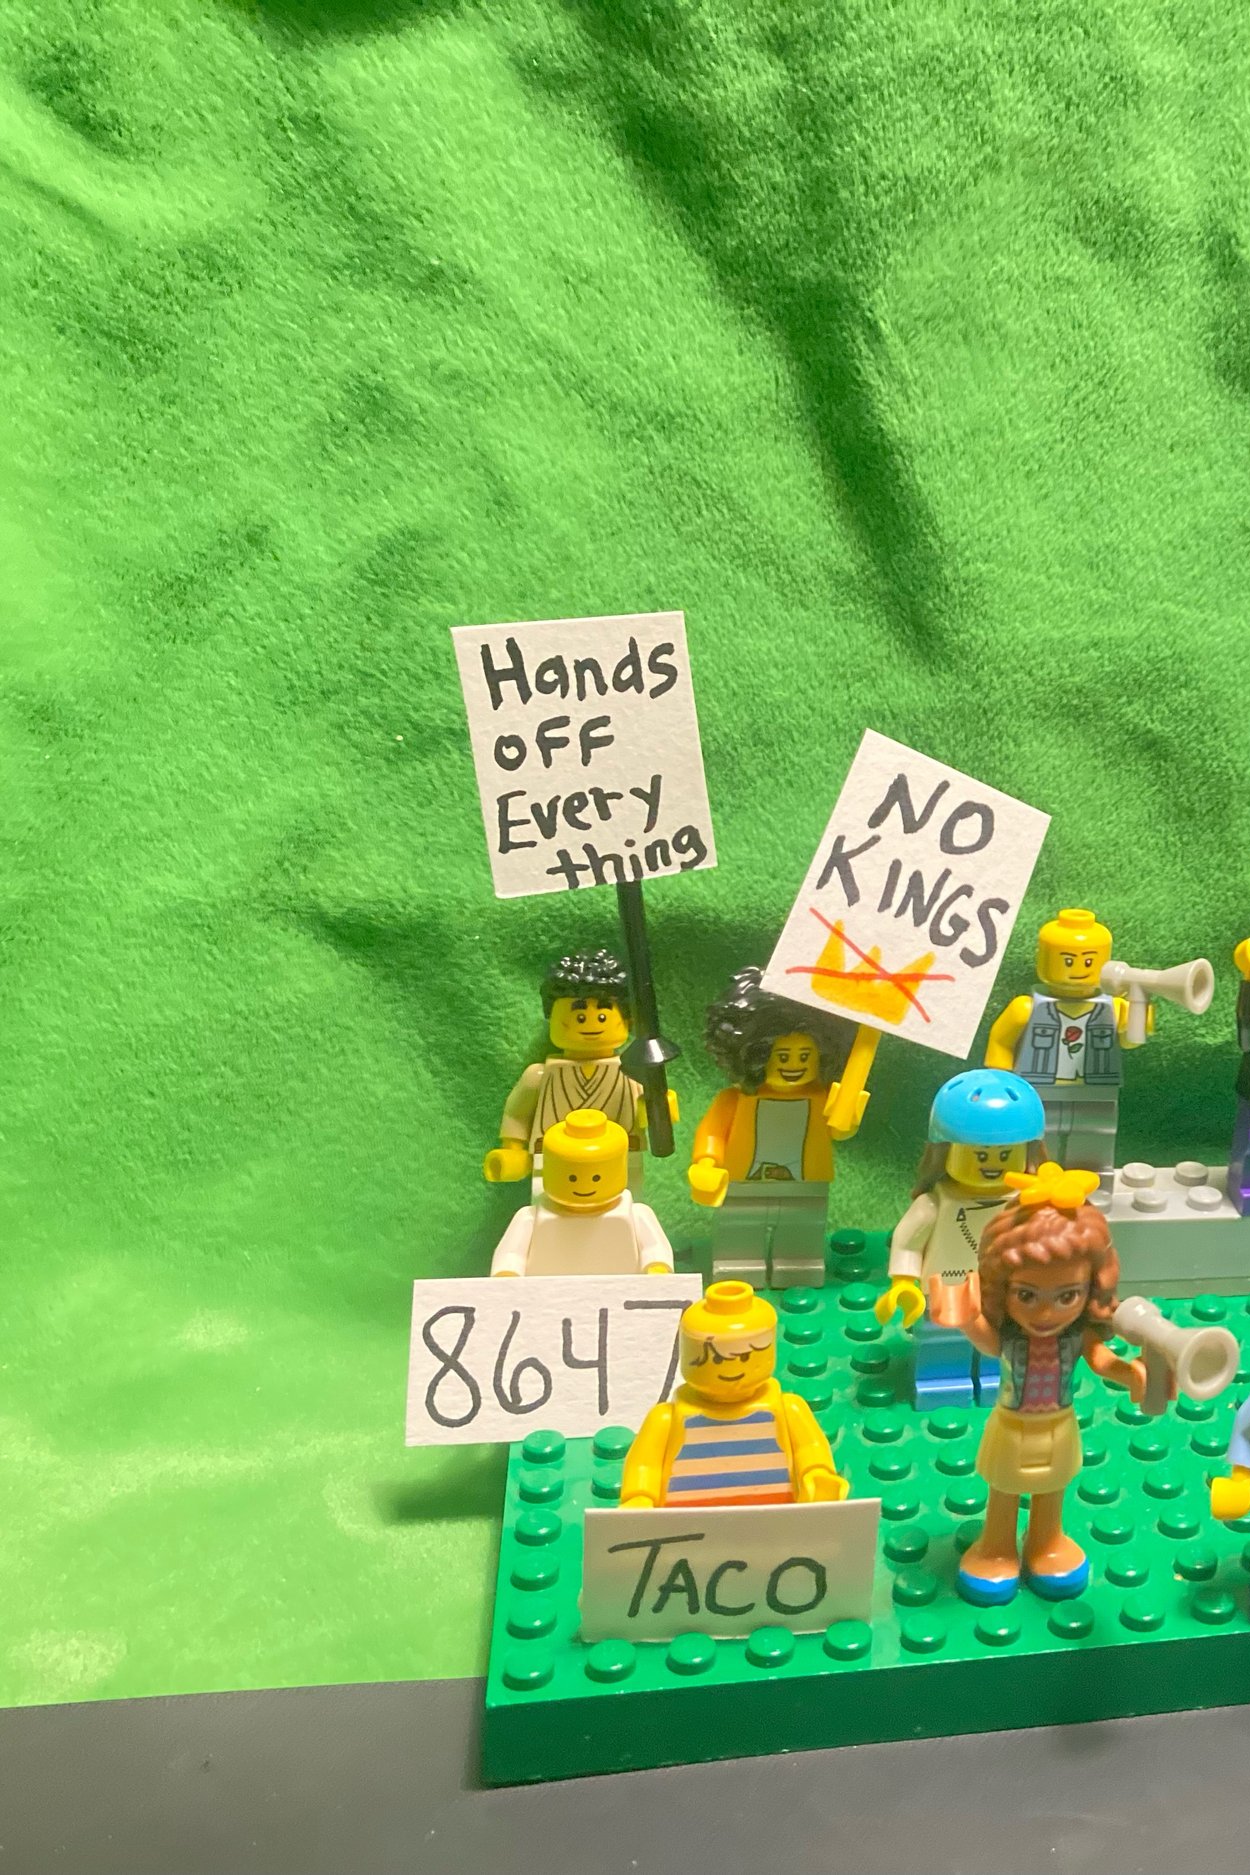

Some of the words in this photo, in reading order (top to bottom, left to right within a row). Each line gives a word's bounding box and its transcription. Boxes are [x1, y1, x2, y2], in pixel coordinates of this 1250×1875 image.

[480, 636, 678, 710] Hands
[497, 774, 662, 854] Every
[867, 773, 993, 855] NO
[546, 825, 707, 890] thing
[816, 834, 1010, 968] KINGS
[422, 1300, 693, 1428] 8647
[608, 1533, 827, 1617] TACO
